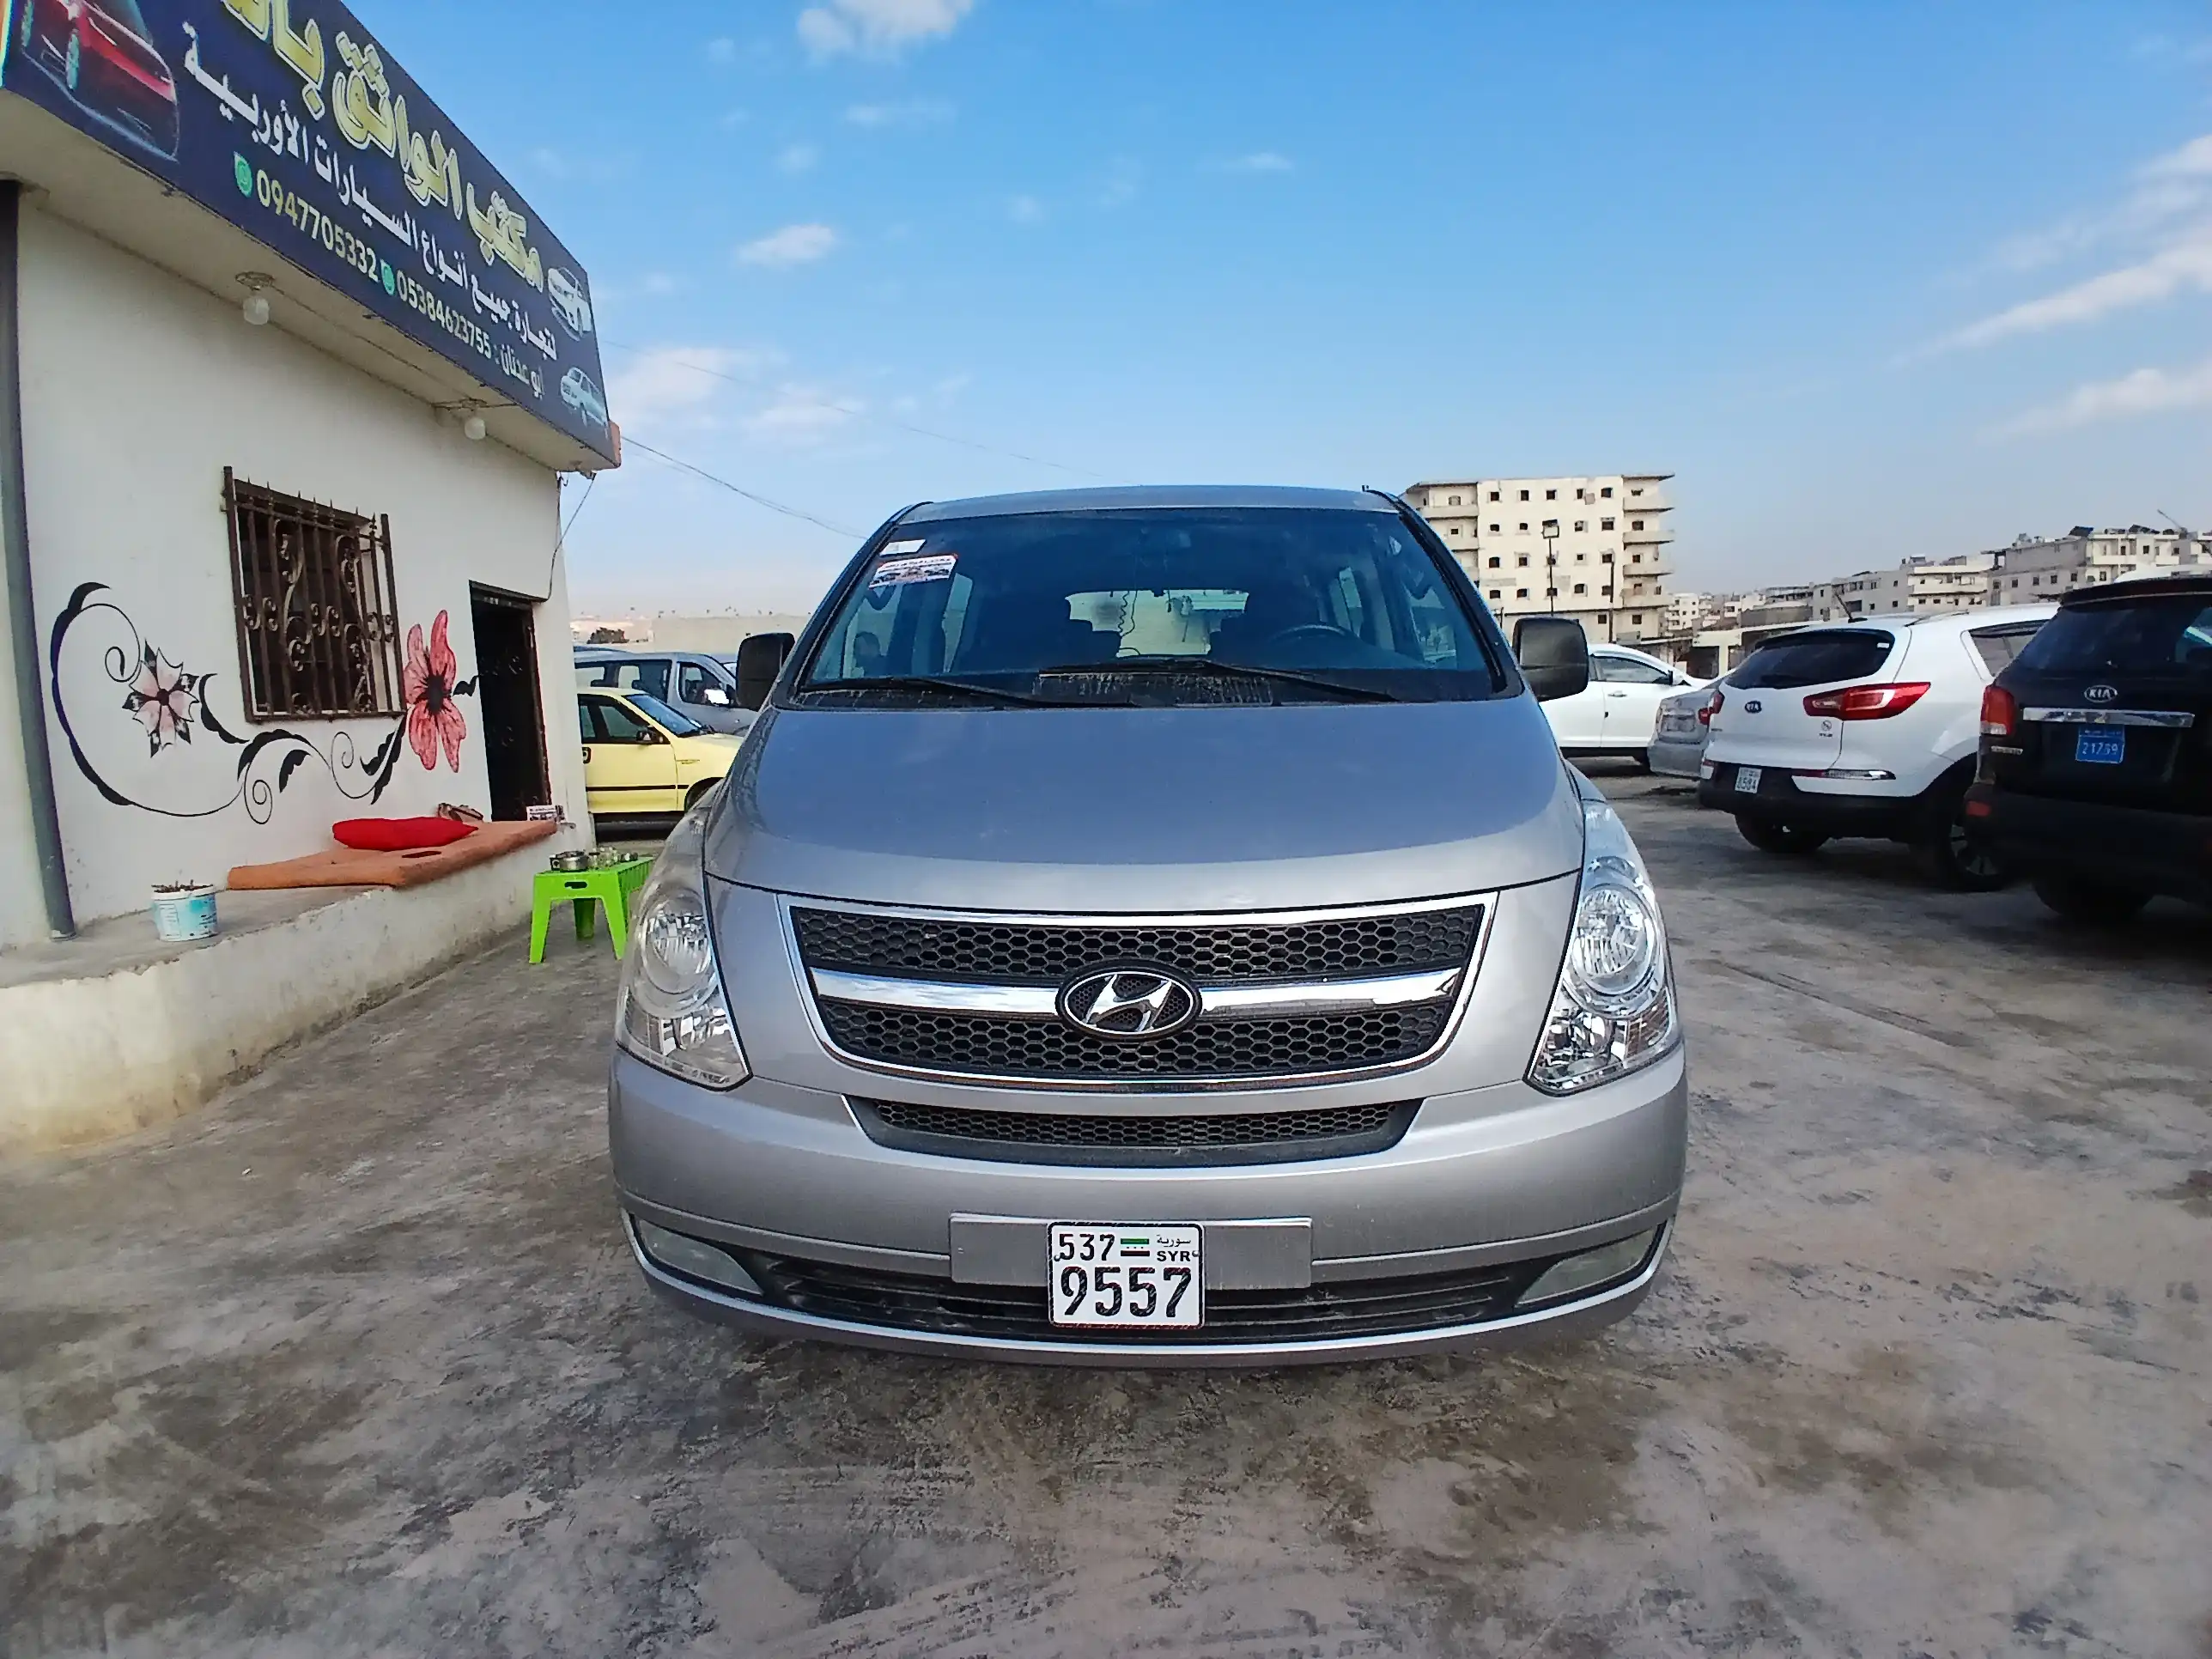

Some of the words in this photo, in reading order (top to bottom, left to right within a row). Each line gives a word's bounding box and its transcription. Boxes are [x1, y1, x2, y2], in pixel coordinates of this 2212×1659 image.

[331, 31, 463, 221] الواثق
[314, 134, 418, 252] السيارات
[257, 169, 380, 283] 0947705332
[466, 182, 544, 293] مكتب
[396, 270, 492, 360] 05384623755
[471, 274, 513, 331] جميع
[512, 300, 557, 361] لتجارة
[1059, 1233, 1116, 1261] 537
[1156, 1234, 1192, 1248] سورية
[1157, 1250, 1191, 1262] SYR
[1060, 1266, 1192, 1318] 9557
